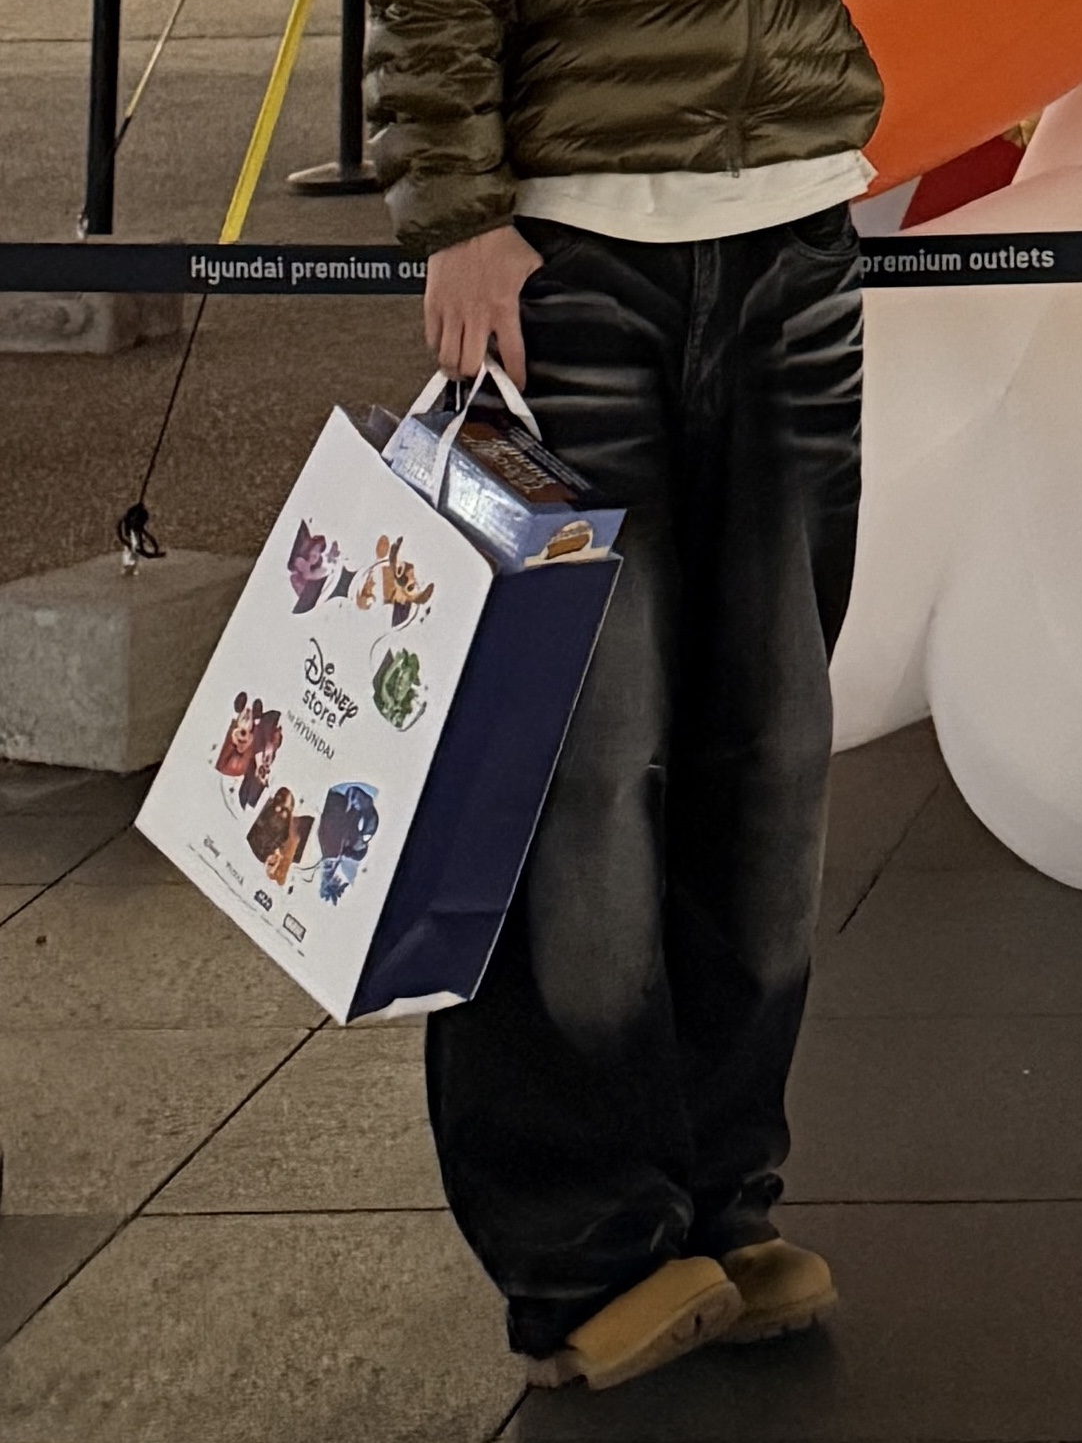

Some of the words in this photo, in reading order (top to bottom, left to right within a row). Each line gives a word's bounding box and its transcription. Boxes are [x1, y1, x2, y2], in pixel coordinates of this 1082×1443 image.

[190, 255, 284, 285] Hyundai
[291, 256, 391, 285] premium
[861, 248, 962, 280] premium
[969, 245, 1055, 271] outlets
[302, 688, 337, 729] store
